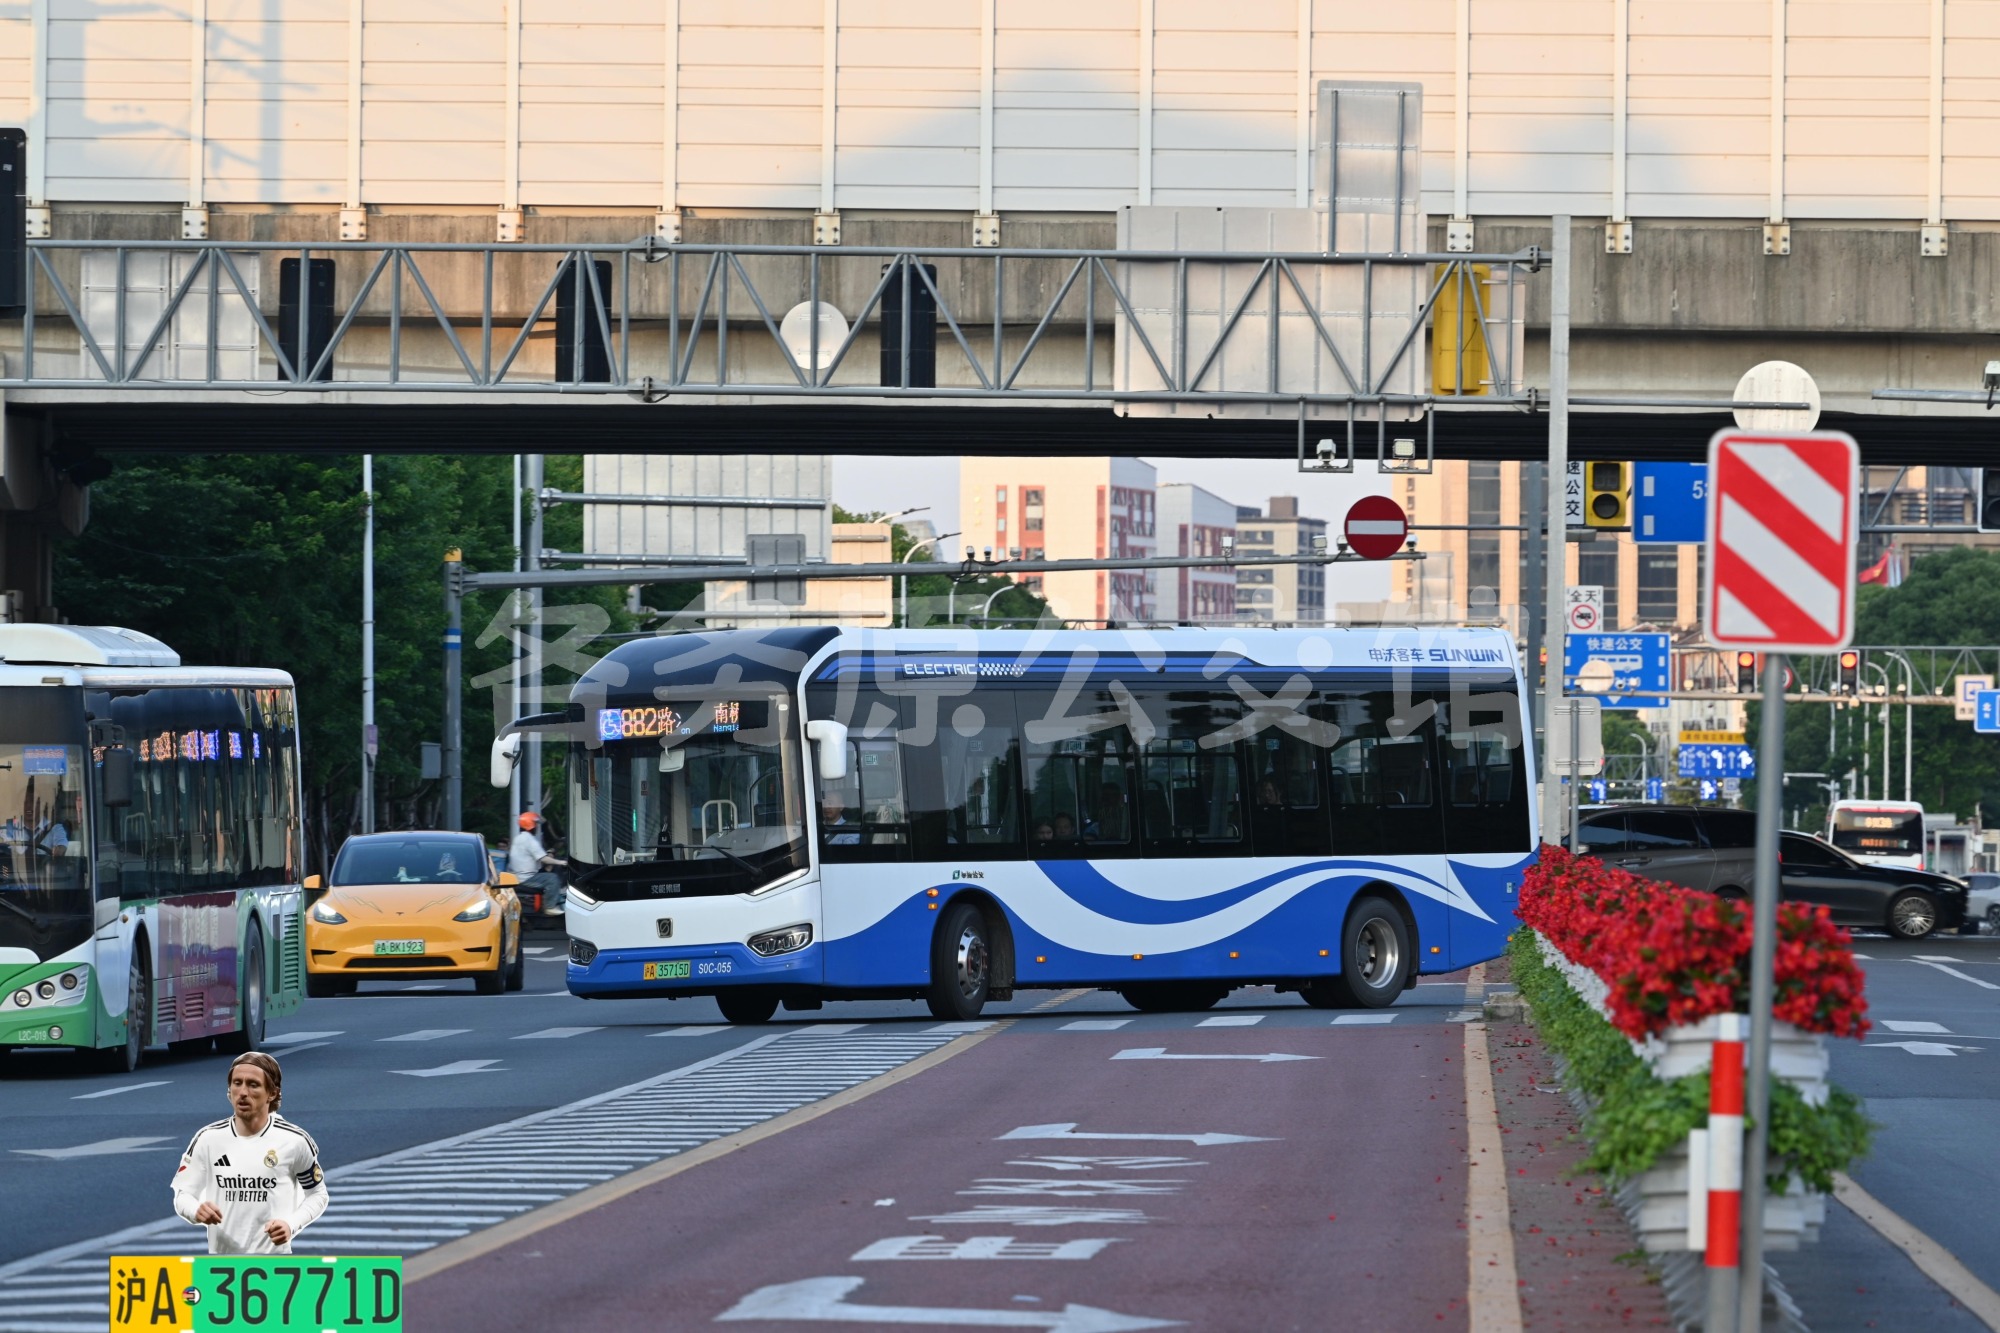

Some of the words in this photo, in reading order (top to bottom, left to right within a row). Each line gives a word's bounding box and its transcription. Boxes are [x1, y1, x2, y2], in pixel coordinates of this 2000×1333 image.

[1570, 589, 1597, 603] 全天
[1586, 637, 1643, 651] 快速公交
[1368, 647, 1424, 663] 申沃客车
[1429, 649, 1504, 663] SUNWIN
[904, 663, 977, 675] ELECTRIC
[621, 706, 674, 737] 882路
[390, 941, 424, 953] BK1923
[658, 963, 689, 977] 35715D
[18, 1030, 47, 1041] L2C-019
[215, 1173, 277, 1190] Emirates
[225, 1190, 238, 1202] FLY
[239, 1190, 268, 1202] BETTER
